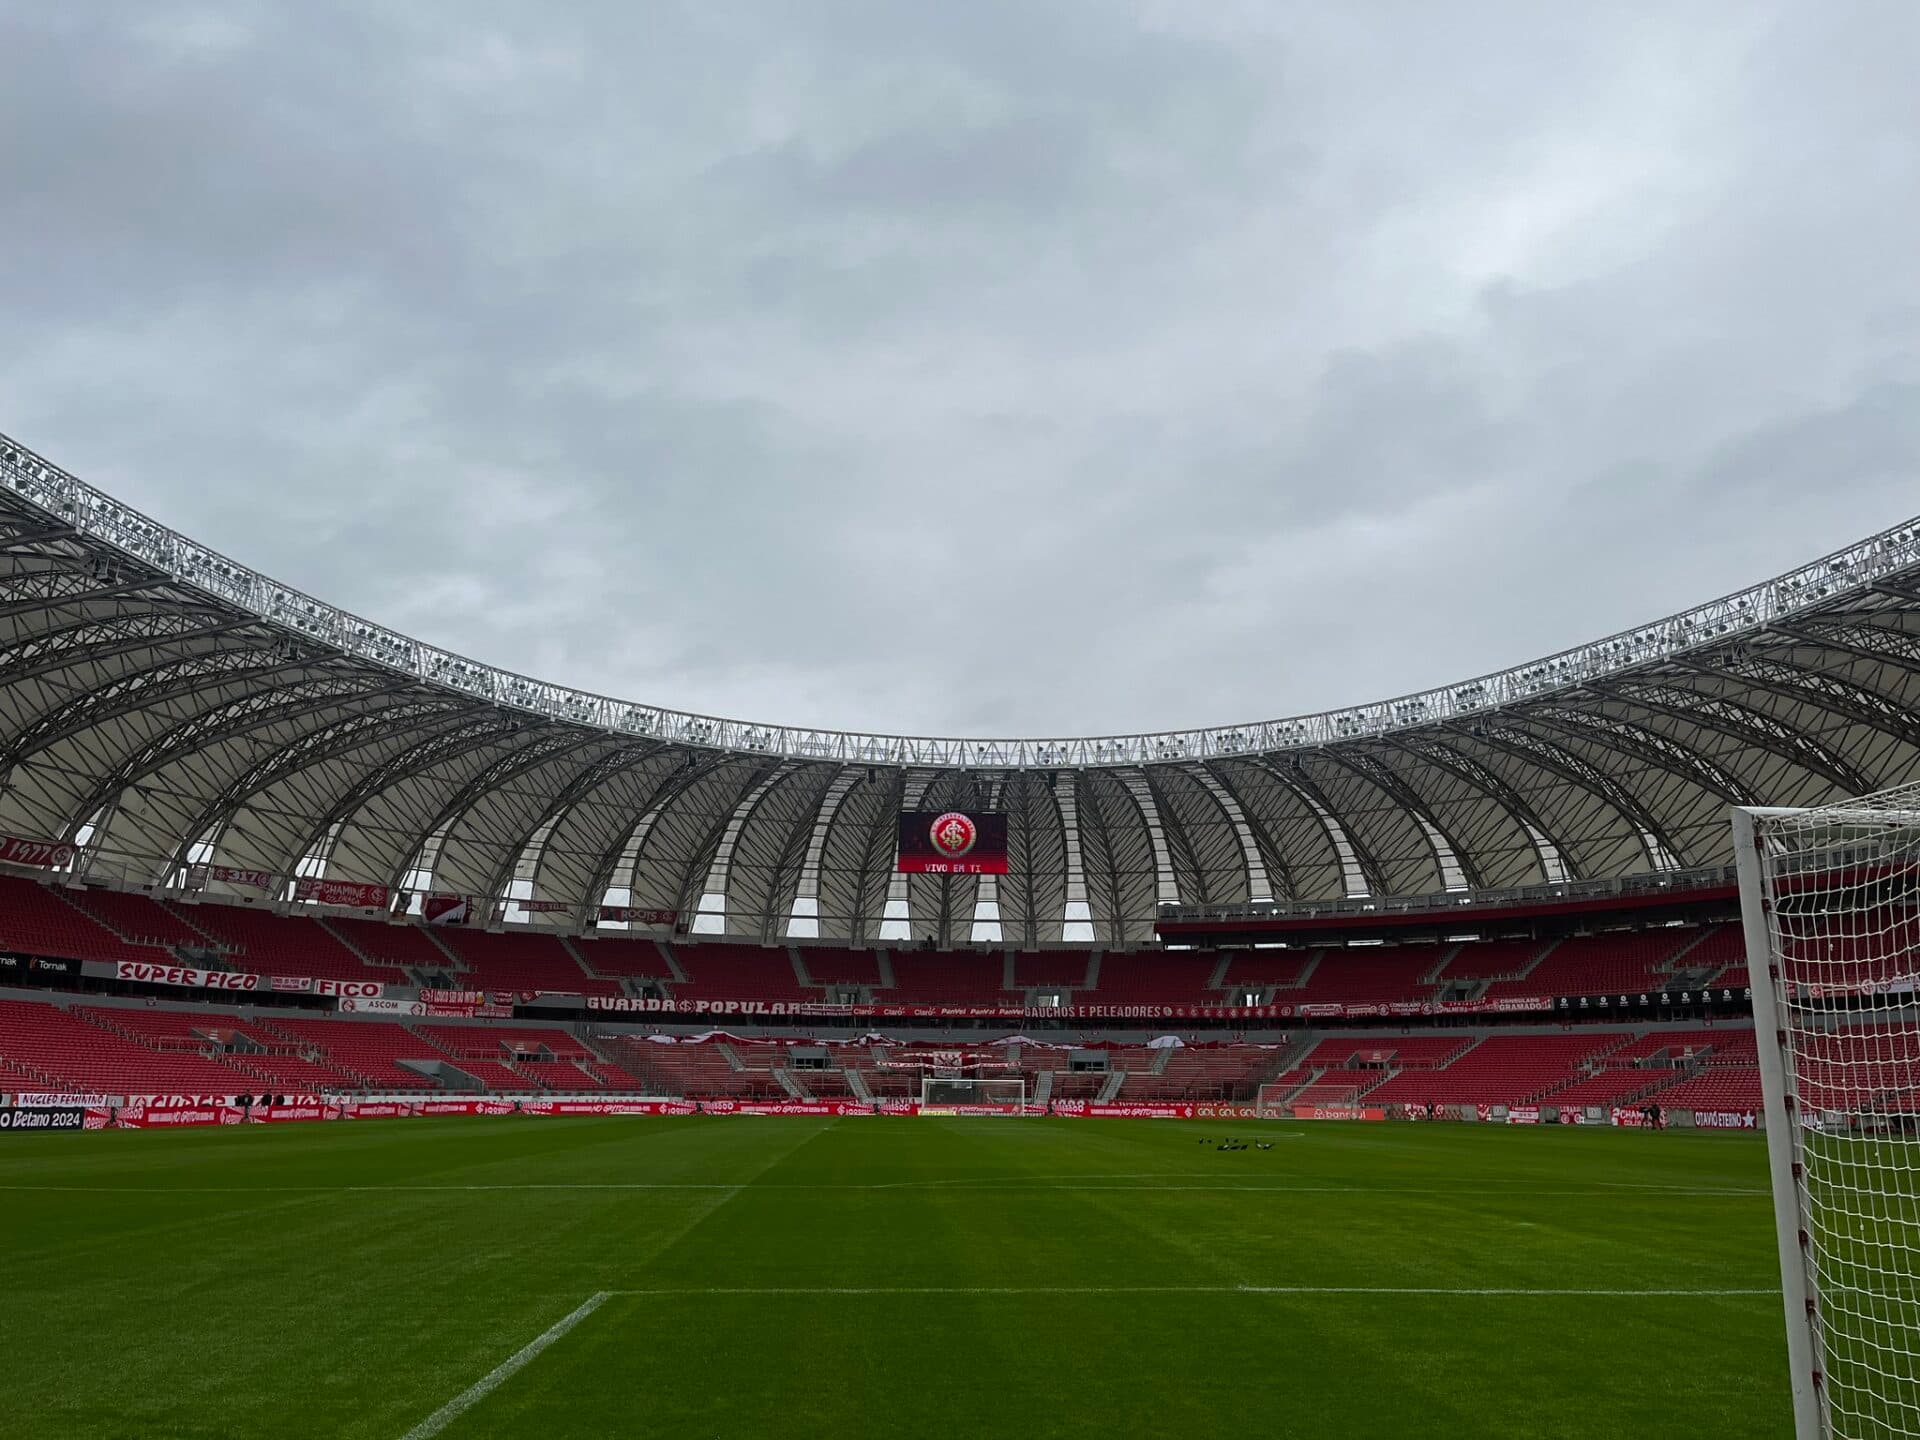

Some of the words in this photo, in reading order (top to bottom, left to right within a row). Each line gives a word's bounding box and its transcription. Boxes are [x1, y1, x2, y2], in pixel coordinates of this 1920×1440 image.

[8, 842, 51, 861] 1977
[925, 864, 948, 872] VIVO
[953, 865, 965, 873] EM
[970, 865, 982, 873] TI
[227, 869, 258, 883] 317
[621, 910, 658, 922] ROOTS
[39, 960, 67, 972] Tornak
[119, 962, 198, 985] SUPER
[205, 972, 257, 989] FICO
[319, 981, 379, 997] FICO
[368, 1001, 399, 1009] ASCOM
[586, 997, 677, 1012] GUARDA
[695, 1001, 801, 1016] POPULAR
[853, 1007, 875, 1015] Claro
[883, 1007, 906, 1016] Claro
[914, 1007, 936, 1016] Claro
[1024, 1006, 1076, 1018] GAUCHOS
[1079, 1006, 1086, 1018] E
[1089, 1006, 1161, 1018] PELEADORES
[12, 1110, 50, 1128] Betano
[51, 1112, 81, 1127] 2024
[1197, 1108, 1216, 1117] GOL
[1219, 1108, 1238, 1117] GOL
[1239, 1108, 1257, 1117] GOL
[1718, 1112, 1742, 1128] ETERNO
